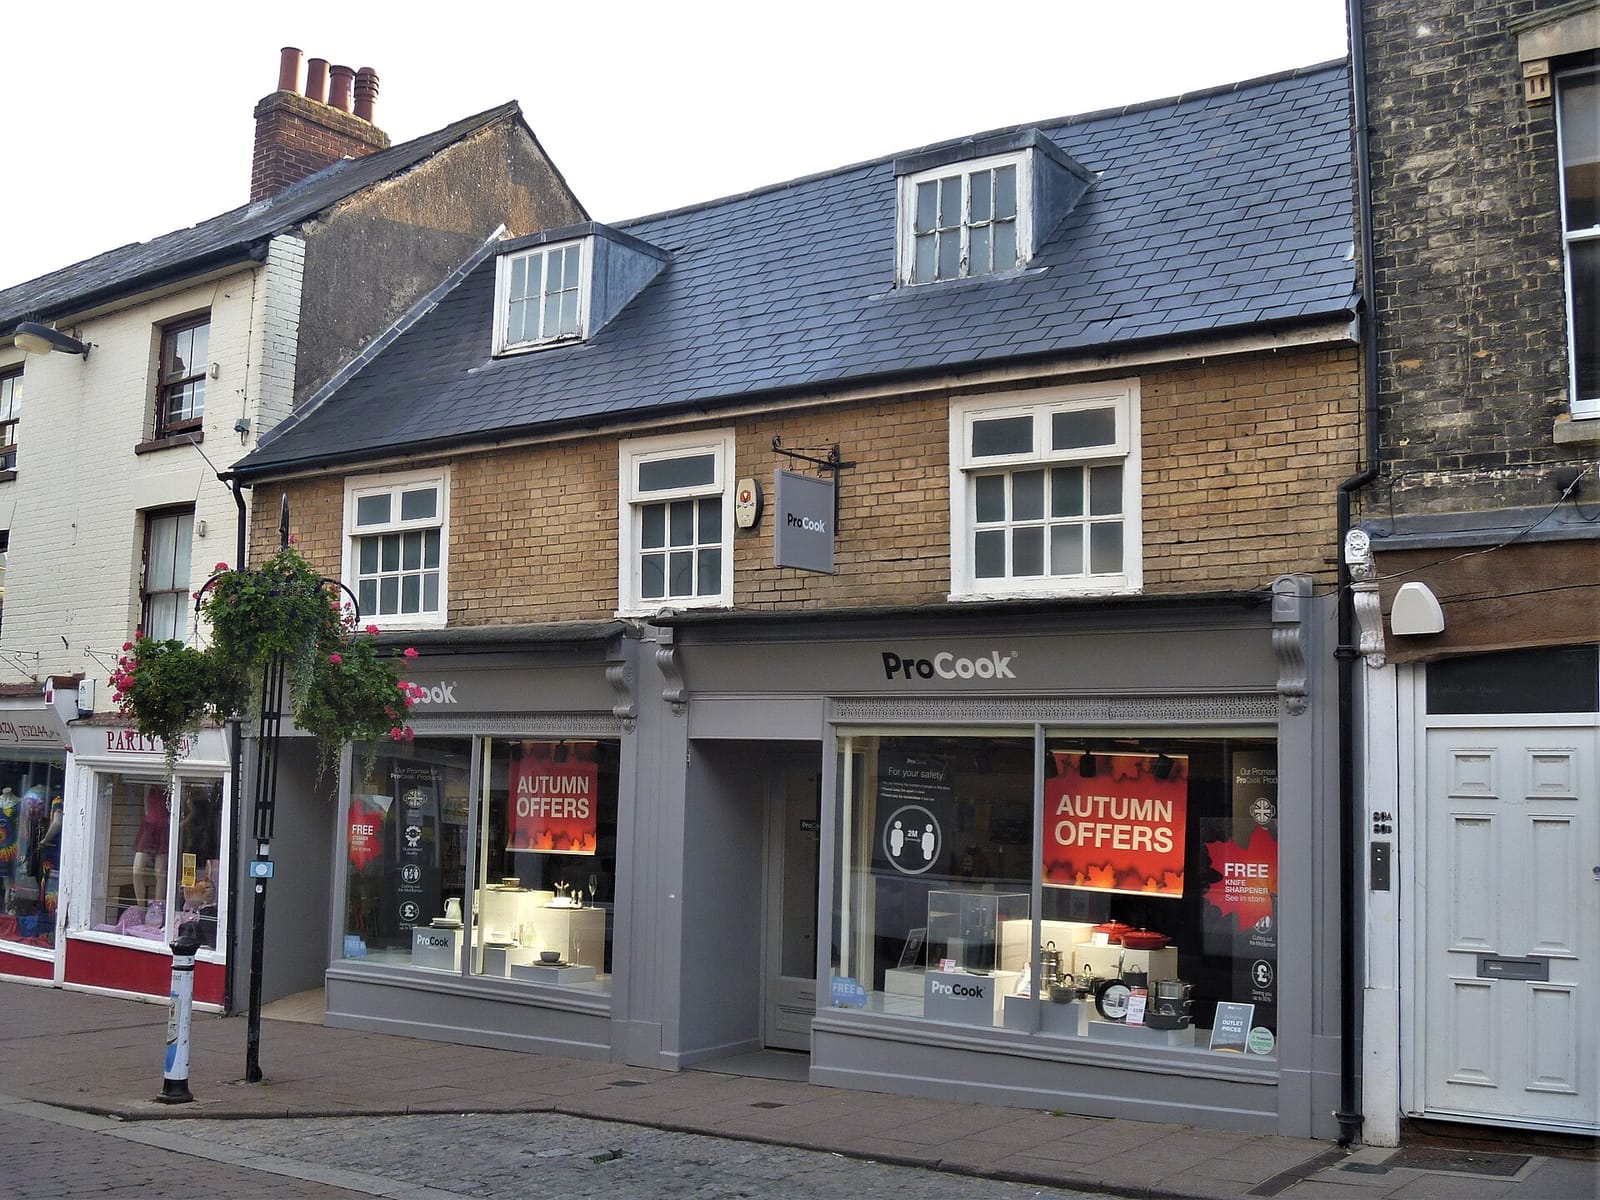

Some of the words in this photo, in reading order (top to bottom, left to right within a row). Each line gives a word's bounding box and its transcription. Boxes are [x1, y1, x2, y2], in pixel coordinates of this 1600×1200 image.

[787, 512, 825, 533] ProCook
[881, 650, 1018, 680] ProCook
[106, 730, 156, 752] PARTY
[888, 766, 900, 776] For
[902, 768, 919, 778] your
[517, 775, 589, 794] AUTUMN
[516, 796, 590, 819] OFFERS
[1055, 794, 1173, 823] AUTUMN
[352, 824, 374, 836] FREE
[1054, 820, 1174, 853] OFFERS
[1224, 862, 1269, 878] FREE
[1225, 879, 1247, 887] KNIFE
[1225, 886, 1269, 894] SHARPENER
[1225, 894, 1239, 902] See
[416, 934, 449, 948] ProCook
[832, 983, 856, 994] FREE
[931, 980, 984, 999] ProCook
